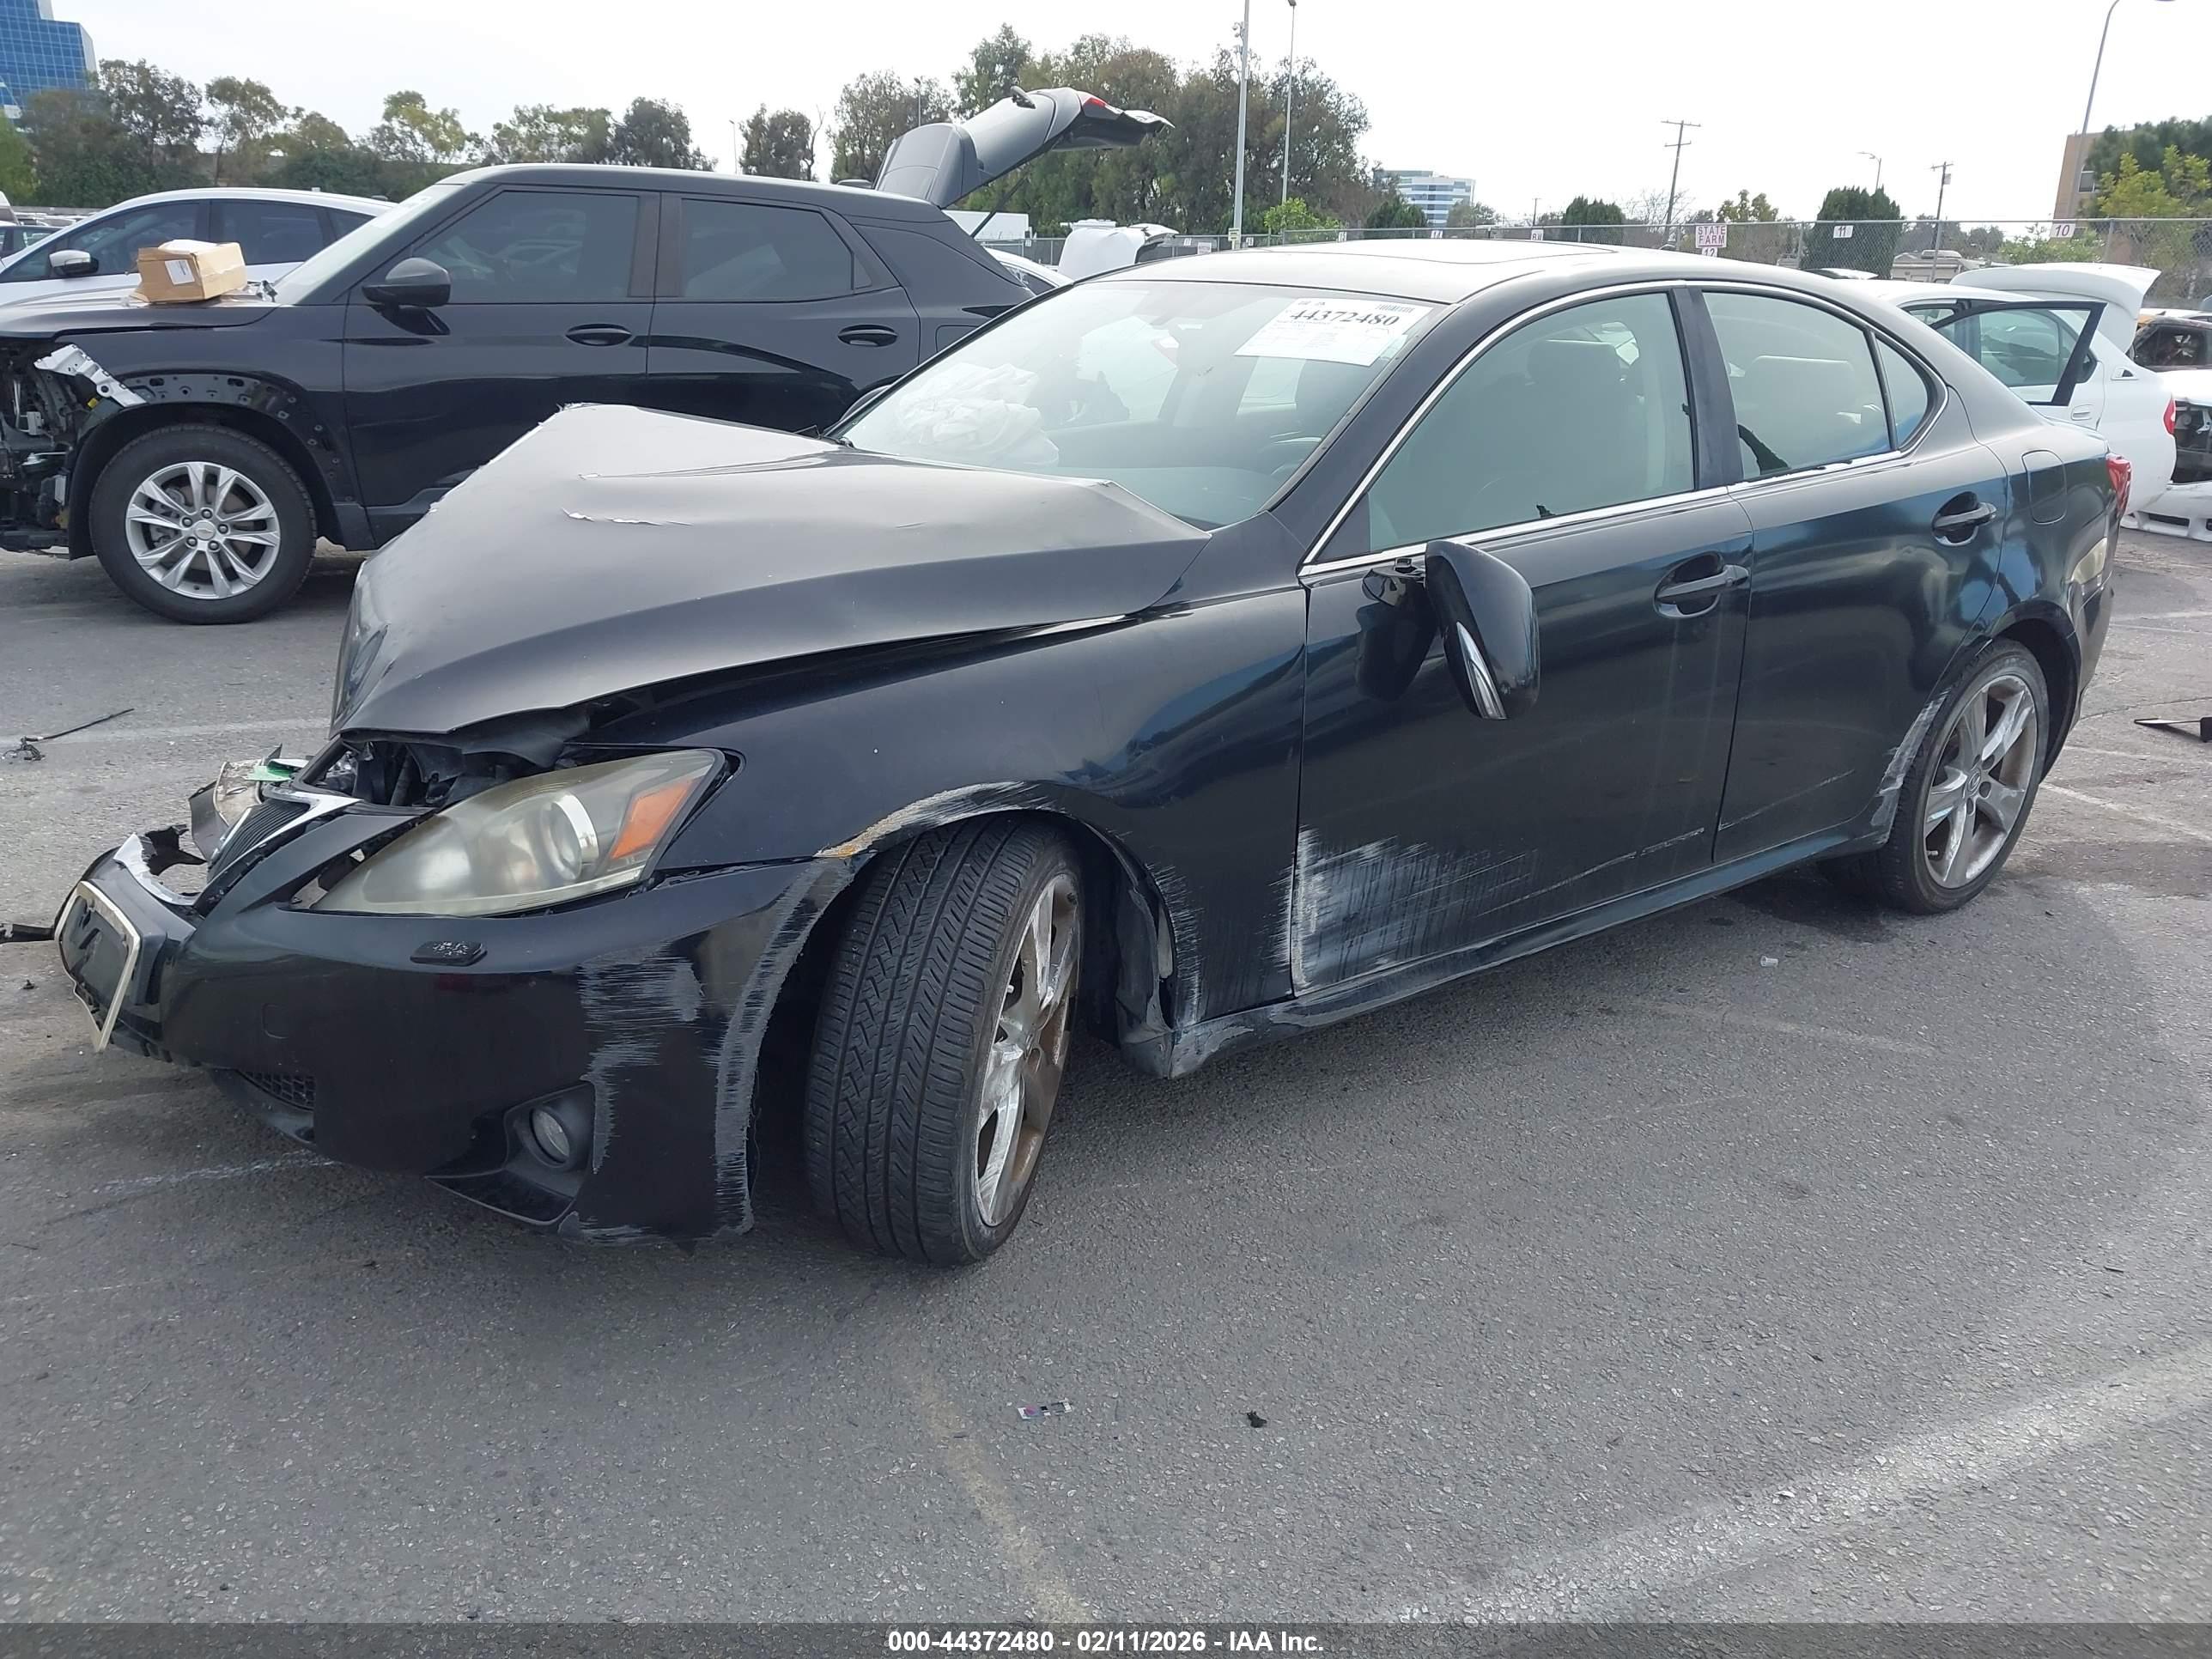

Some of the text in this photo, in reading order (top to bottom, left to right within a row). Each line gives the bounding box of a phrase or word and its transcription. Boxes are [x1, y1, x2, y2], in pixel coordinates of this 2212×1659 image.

[1698, 225, 1726, 234] STATE
[2055, 224, 2070, 236] 10
[1699, 235, 1725, 244] FARM
[1290, 309, 1401, 326] 44372480
